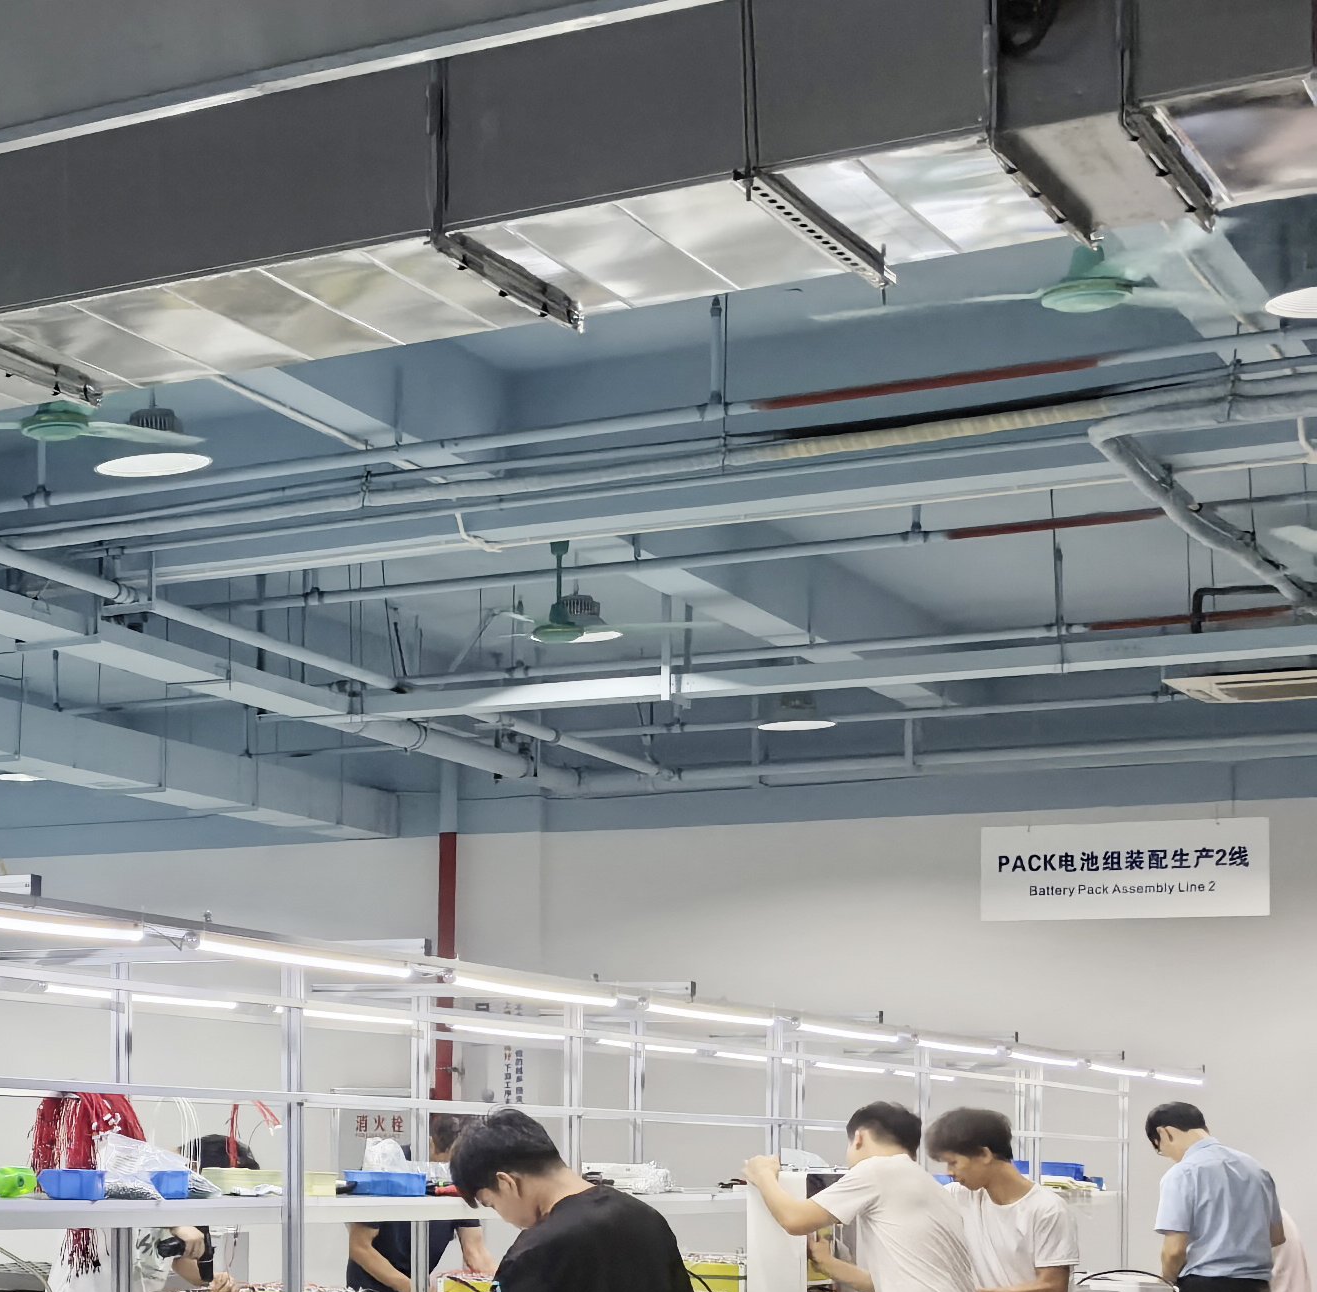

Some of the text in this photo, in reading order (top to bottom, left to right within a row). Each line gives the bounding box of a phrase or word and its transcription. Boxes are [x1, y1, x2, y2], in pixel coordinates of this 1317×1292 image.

[998, 846, 1249, 872] PACK电池组装配生产2线
[1029, 880, 1216, 897] Battery Pack Assembly Line 2
[356, 1114, 404, 1133] 消火栓
